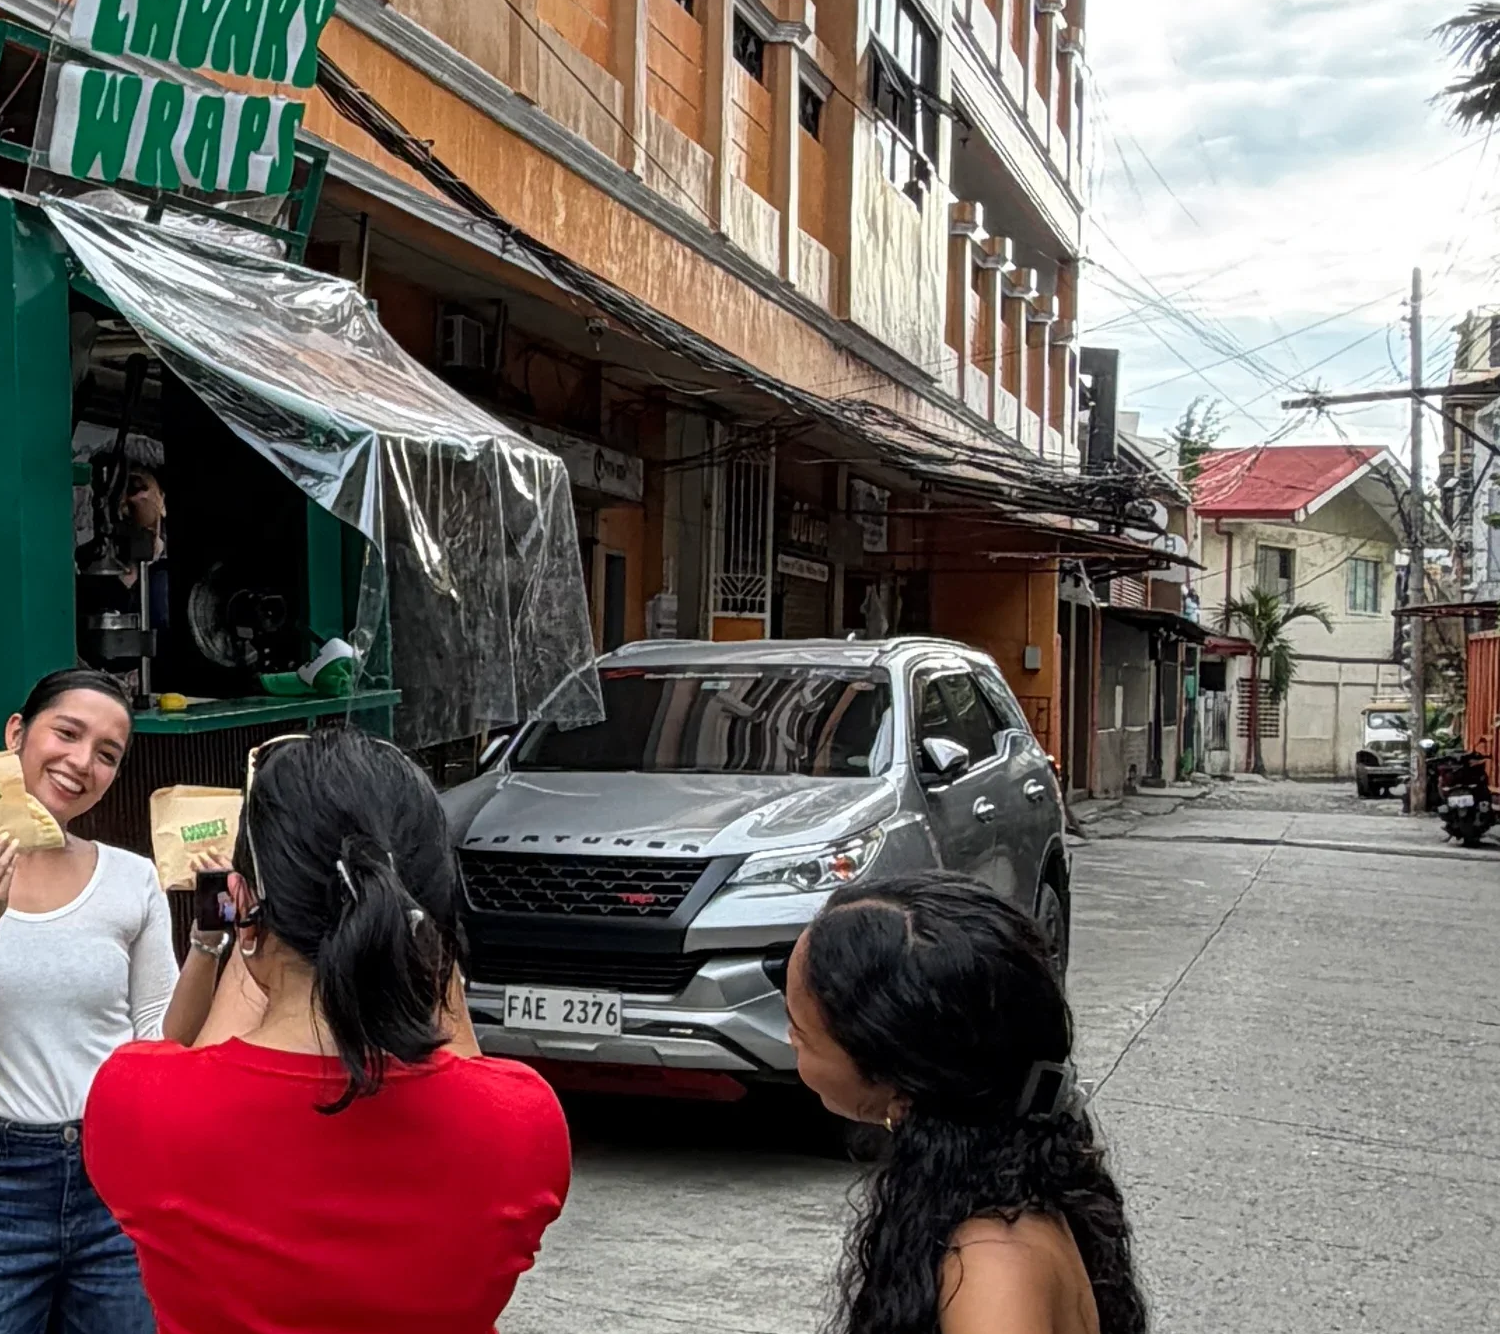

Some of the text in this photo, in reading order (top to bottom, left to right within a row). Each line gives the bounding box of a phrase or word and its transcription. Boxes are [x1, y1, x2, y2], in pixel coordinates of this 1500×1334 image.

[73, 69, 306, 193] WRAPS
[466, 835, 700, 853] FORTUNER
[508, 995, 618, 1026] FAE 2376
